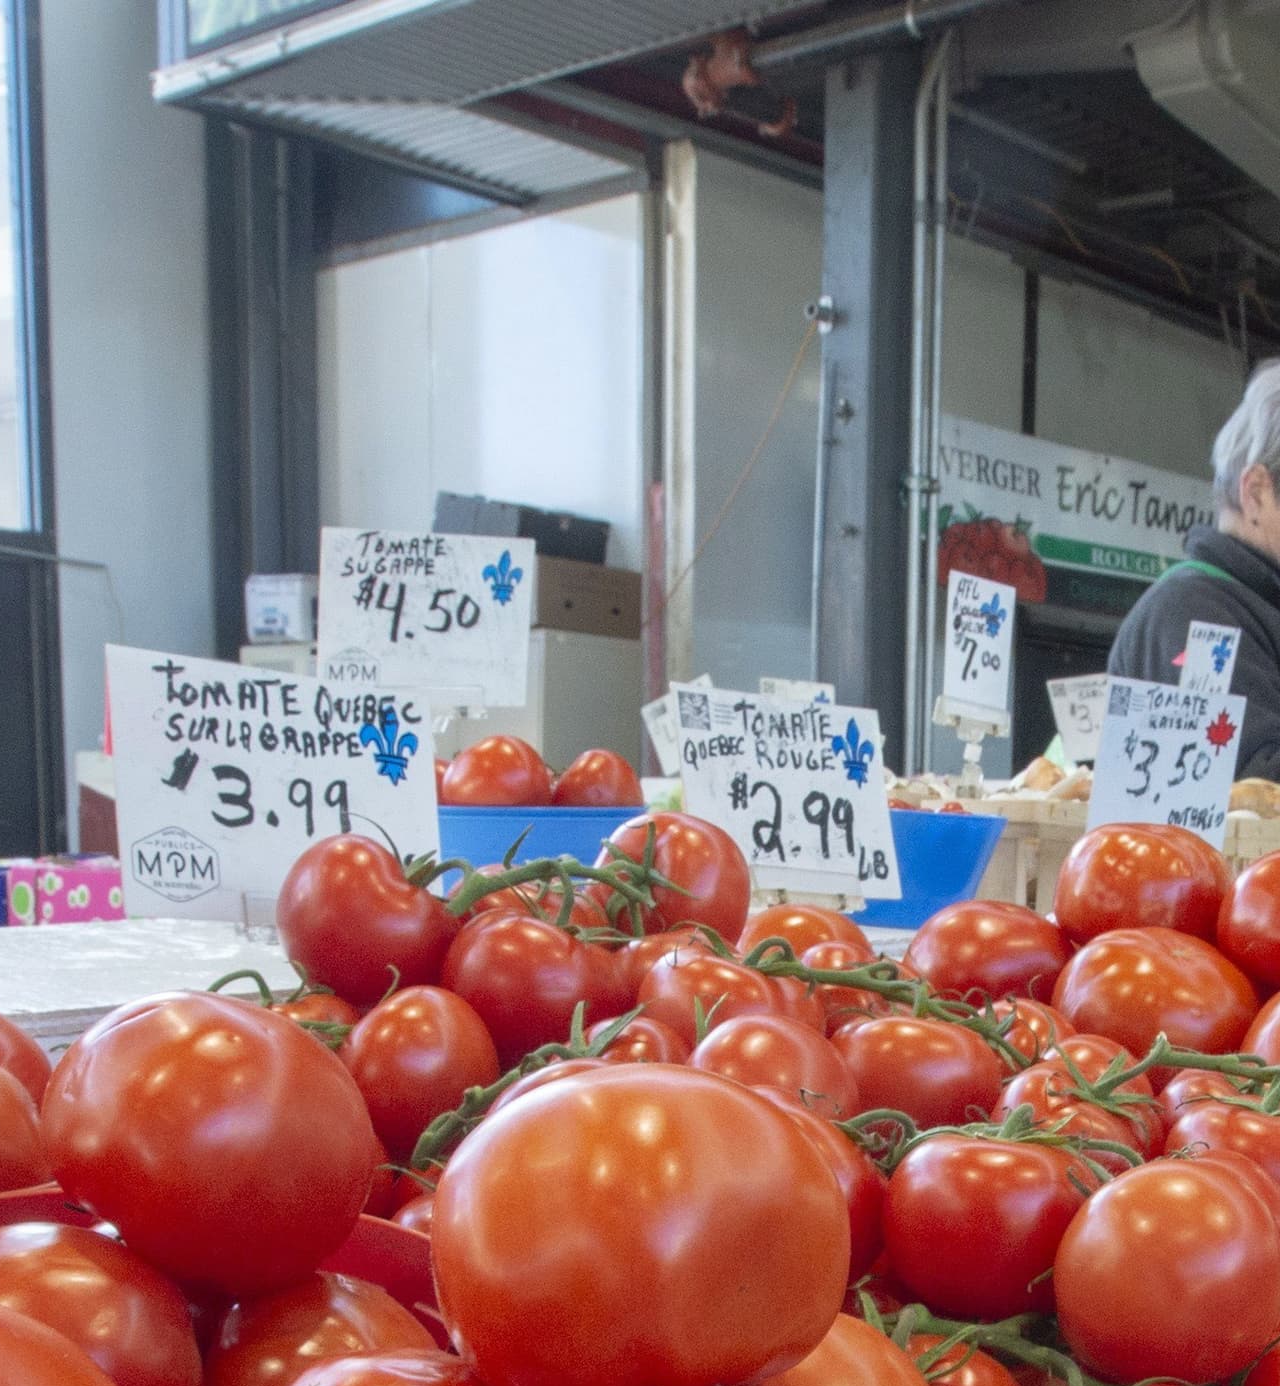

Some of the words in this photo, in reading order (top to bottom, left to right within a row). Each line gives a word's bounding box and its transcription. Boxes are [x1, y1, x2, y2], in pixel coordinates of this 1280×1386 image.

[941, 446, 1042, 498] VERGER
[1055, 464, 1126, 522] Eric
[356, 531, 447, 557] TOMATE
[353, 574, 481, 642] $4.50
[328, 663, 377, 682] MPM
[1147, 686, 1210, 716] TOMATE
[165, 712, 218, 744] SUR
[755, 741, 837, 772] ROUGE
[728, 771, 855, 862] $2.99
[137, 849, 215, 881] MPM
[858, 846, 889, 881] LB
